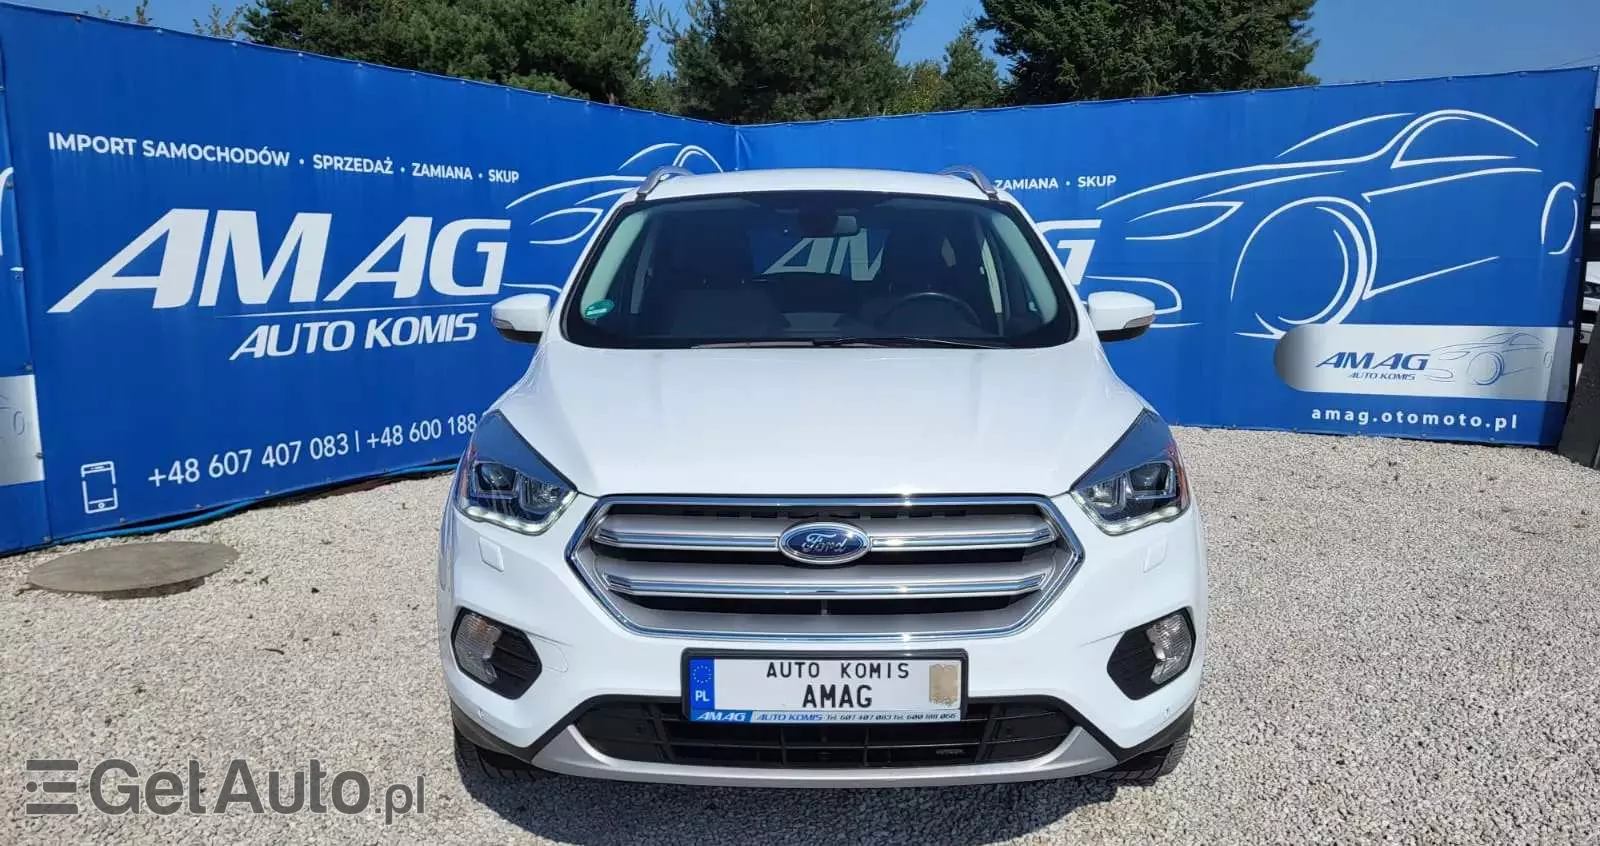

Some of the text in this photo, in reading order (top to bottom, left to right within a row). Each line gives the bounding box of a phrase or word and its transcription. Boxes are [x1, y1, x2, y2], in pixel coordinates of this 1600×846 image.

[48, 131, 520, 184] IMPORT SAMOCHODÓW SPRZEDAŻ ZAMIANA SKUP
[994, 174, 1117, 191] ZAMIANA SKUP
[46, 207, 512, 314] AMAG
[229, 313, 480, 361] AUTO KOMIS
[1315, 351, 1431, 371] AMAG
[1348, 372, 1416, 381] AUTO KOMIS
[1311, 407, 1517, 431] amag.otomoto.pl
[147, 412, 477, 489] +48 607 407 083 +48 600 188
[801, 533, 848, 553] Ford
[766, 662, 909, 679] AUTO KOMIS
[695, 690, 710, 702] PL
[802, 684, 872, 708] AMAG
[697, 711, 746, 722] AMAG
[757, 713, 786, 721] AUTO
[788, 713, 823, 721] KOMIS
